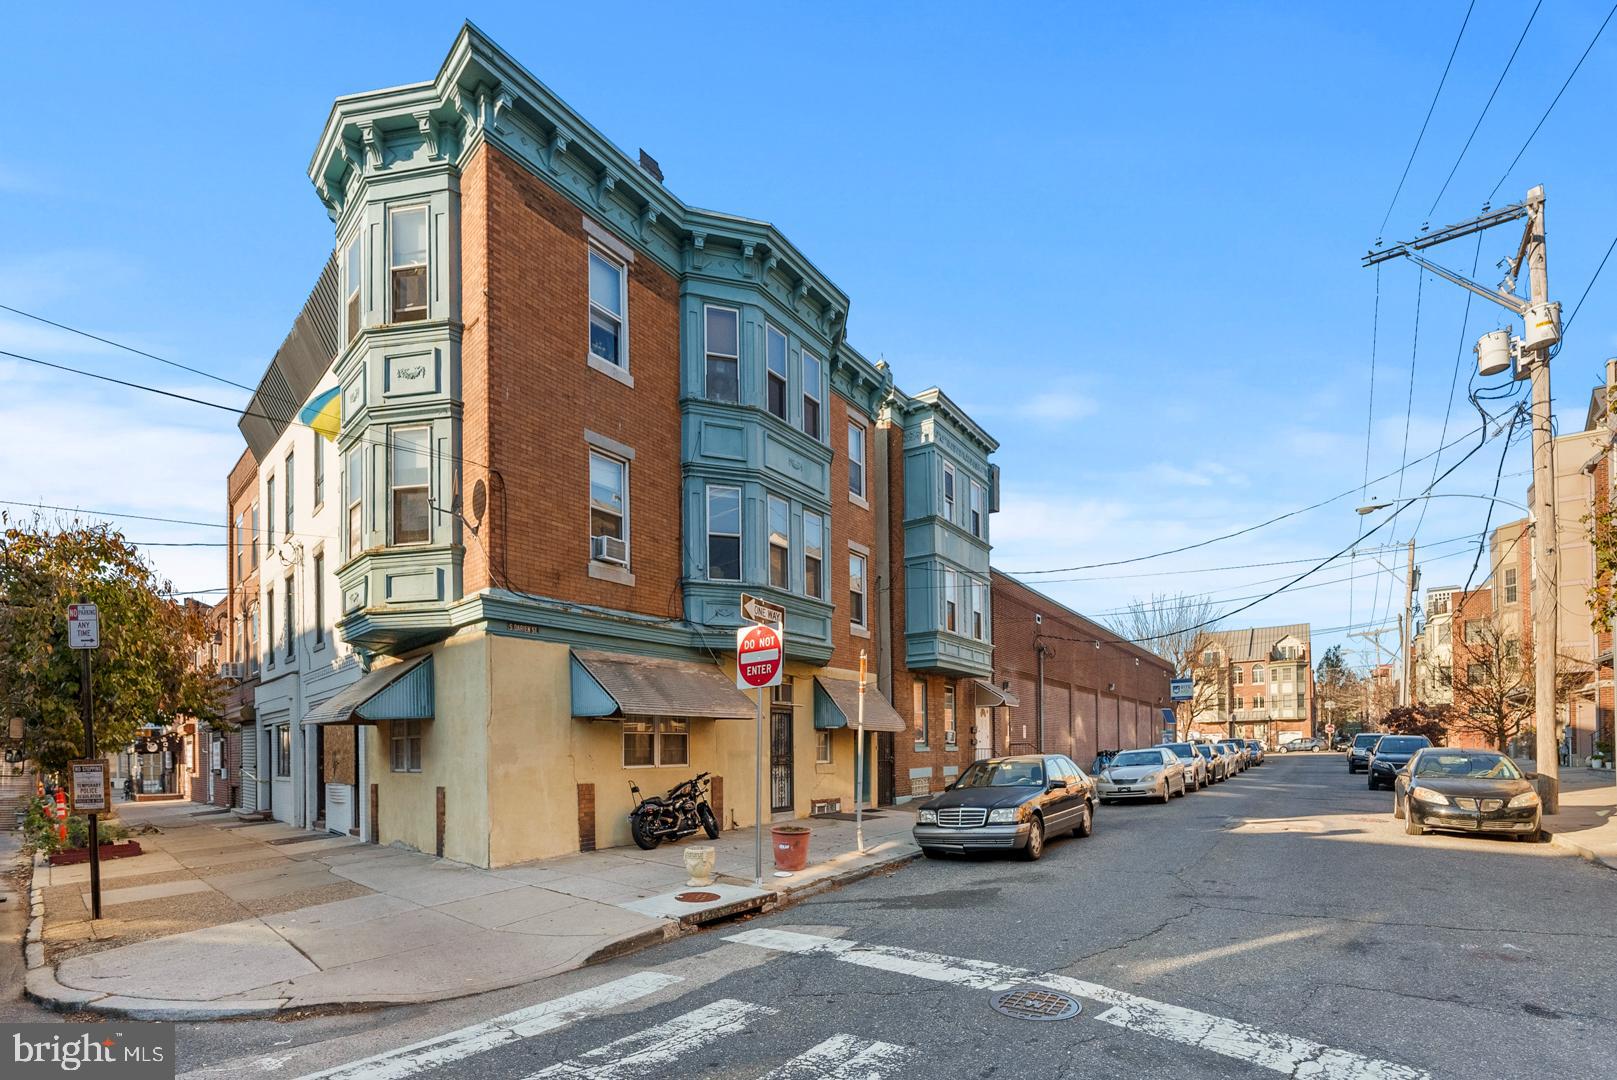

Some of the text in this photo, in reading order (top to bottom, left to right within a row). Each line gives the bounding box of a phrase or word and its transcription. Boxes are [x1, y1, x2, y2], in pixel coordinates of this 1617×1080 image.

[70, 608, 78, 618] NO
[754, 606, 780, 620] ONE WAY
[744, 635, 776, 650] DO NOT
[746, 663, 773, 677] ENTER
